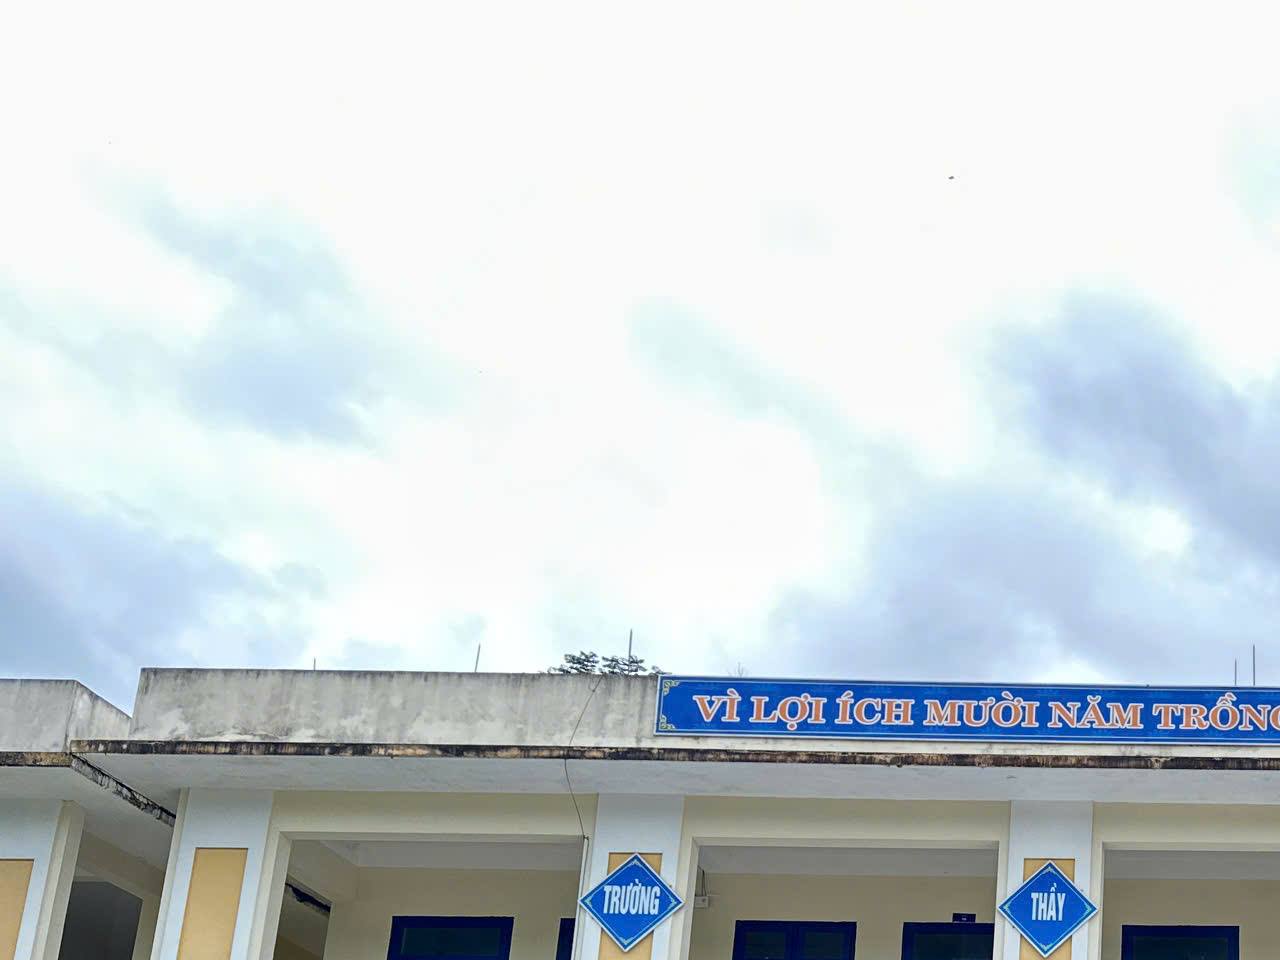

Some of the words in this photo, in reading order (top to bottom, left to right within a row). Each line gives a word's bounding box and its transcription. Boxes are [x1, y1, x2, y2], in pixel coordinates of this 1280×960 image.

[693, 688, 740, 722] VÌ
[749, 693, 826, 730] LỢI
[835, 691, 904, 726] ÍCH
[923, 691, 1039, 728] MƯỜI
[1049, 695, 1144, 730] NĂM
[603, 878, 660, 915] TRƯỜNG
[1031, 882, 1066, 921] THẦY
